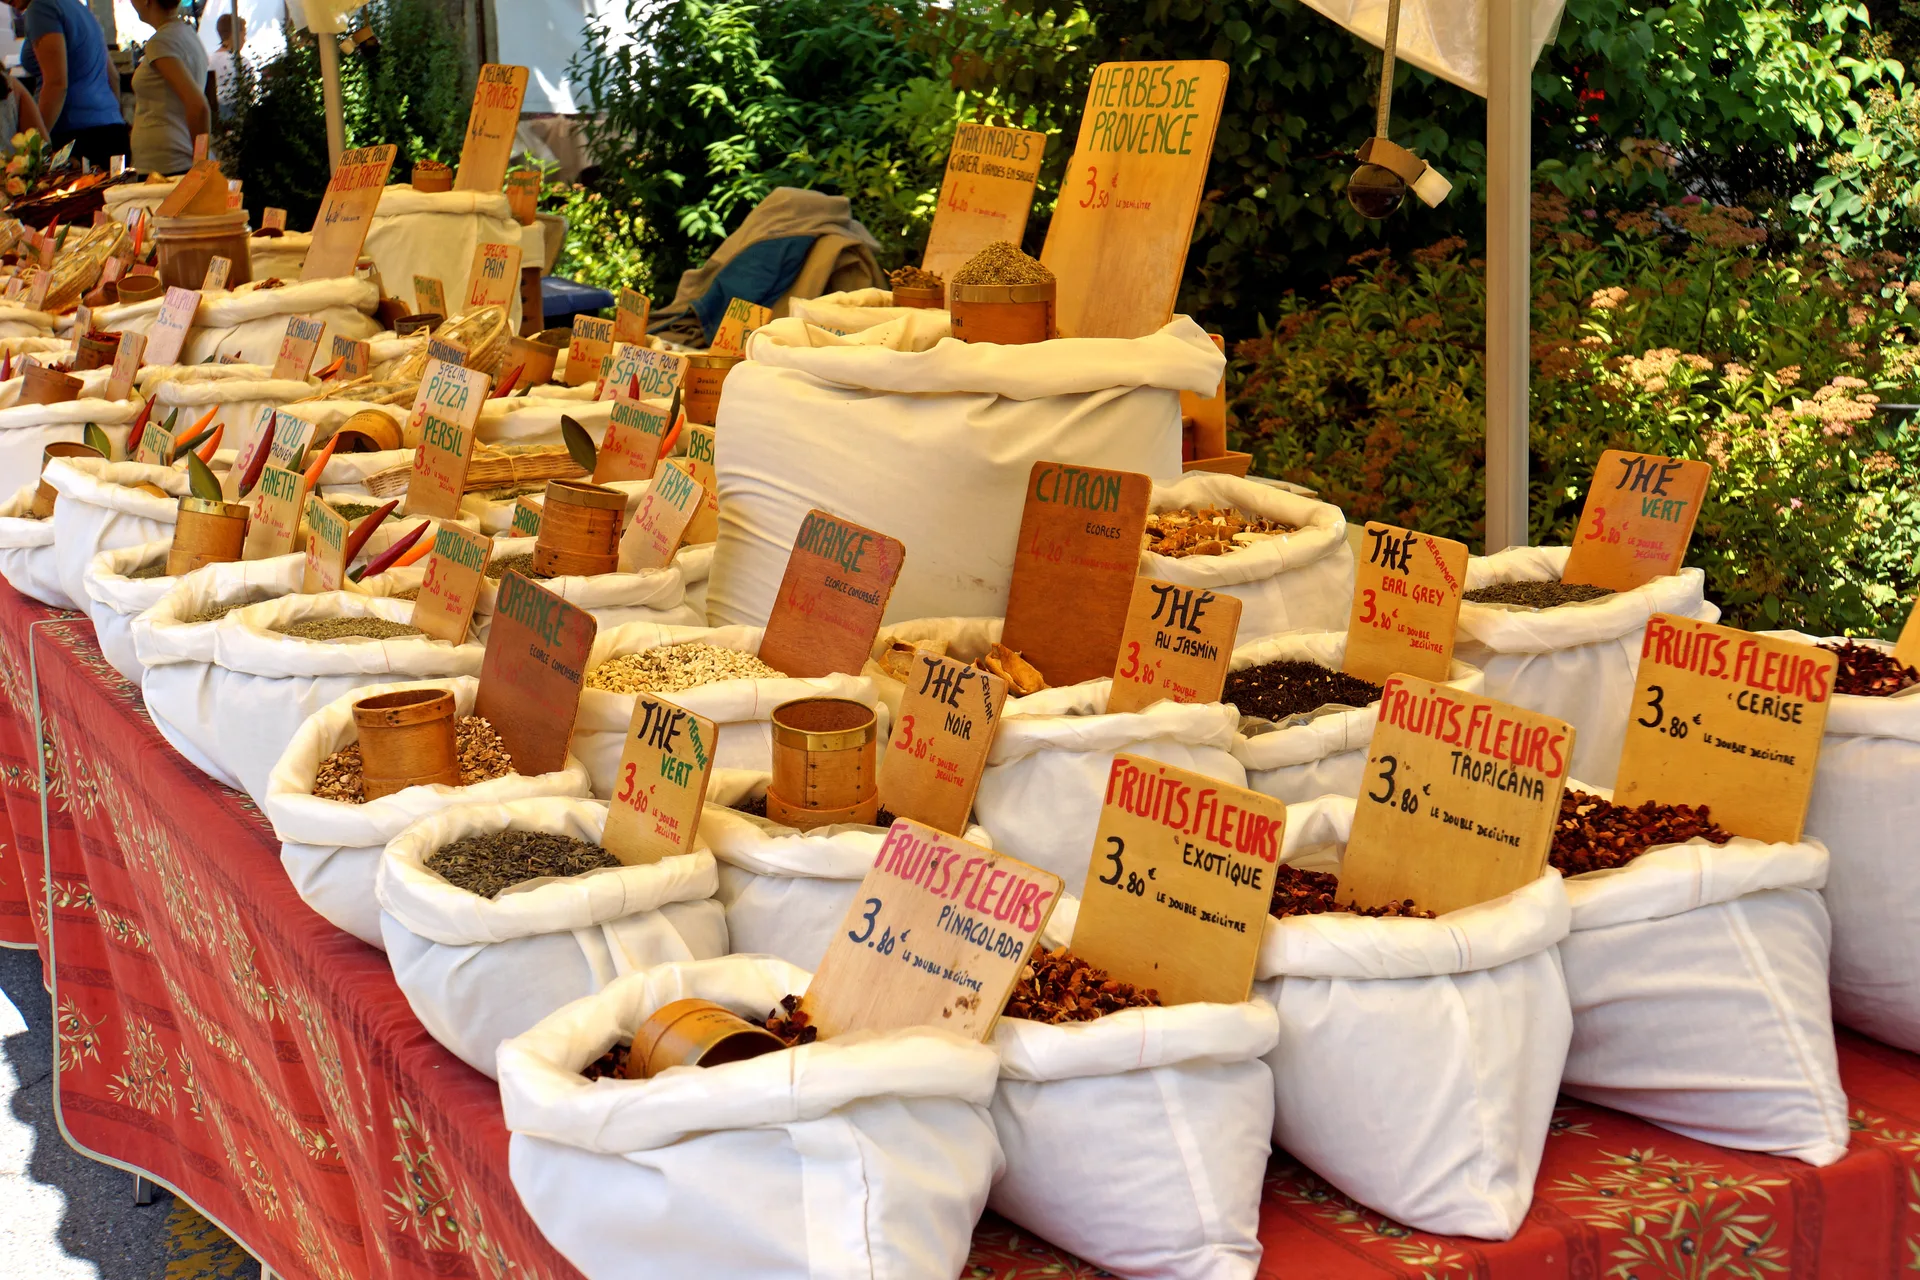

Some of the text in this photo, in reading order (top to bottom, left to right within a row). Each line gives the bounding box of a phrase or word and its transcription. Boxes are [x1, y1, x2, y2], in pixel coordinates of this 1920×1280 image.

[1092, 65, 1199, 109] HERBES DE
[955, 126, 1031, 161] MARINADES
[1089, 110, 1199, 155] PROVENCE
[482, 257, 507, 280] PAIN
[726, 299, 755, 323] ANIS
[332, 335, 357, 360] PAVOT
[427, 338, 467, 365] CORIANDRE
[659, 354, 680, 371] POUR
[437, 363, 468, 383] SPECIAL
[426, 375, 469, 411] PIZZA
[424, 415, 463, 457] PERSIL
[610, 402, 667, 437] CORIANDRE
[142, 423, 171, 459] ANETH
[261, 467, 298, 503] ANETH
[656, 463, 695, 511] THYM
[1035, 464, 1122, 513] CITRON
[1616, 456, 1683, 496] THÉ
[309, 499, 343, 552] ROMARIN
[1641, 497, 1688, 524] VERT
[798, 513, 872, 574] ORANGE
[1085, 522, 1121, 540] ECORCES
[435, 527, 487, 573] MARJOLAINE
[1368, 528, 1418, 576] THÉ
[824, 575, 847, 593] ECORCE
[1381, 576, 1444, 607] EARL GREY
[497, 572, 572, 648] ORANGE
[1151, 584, 1215, 635] THÉ
[1155, 631, 1218, 662] AU JASMIN
[1397, 623, 1430, 640] LE DOUBLE
[1409, 638, 1444, 654] DECILITRE
[529, 643, 550, 665] ECORCE
[1733, 640, 1832, 703] FLEURS
[919, 656, 976, 709] THÉ
[1163, 679, 1197, 698] LE DOUBLE
[1736, 690, 1804, 724] CERISE
[637, 700, 709, 771] THÉ MENTHE
[944, 711, 972, 741] NOIR
[1464, 705, 1565, 779] FLEURS
[929, 753, 959, 773] LE DOUBLE
[1703, 733, 1796, 766] LE DOUBLE DECILITRE
[660, 752, 694, 788] VERT
[935, 769, 965, 788] DECILITRE
[1451, 751, 1545, 802] TROPICANA
[652, 806, 680, 829] LE DOUBLE
[1192, 789, 1283, 863] FLEURS
[1430, 806, 1521, 848] LE DOUBLE DECILITRE
[1183, 842, 1263, 891] EXOTIQUE
[950, 858, 1054, 933] FLEURS
[1156, 891, 1246, 933] LE DOUBLE DECILITRE
[937, 904, 1025, 964] PINACOLADA
[902, 949, 983, 992] LE DOUBLE DECILITRE
